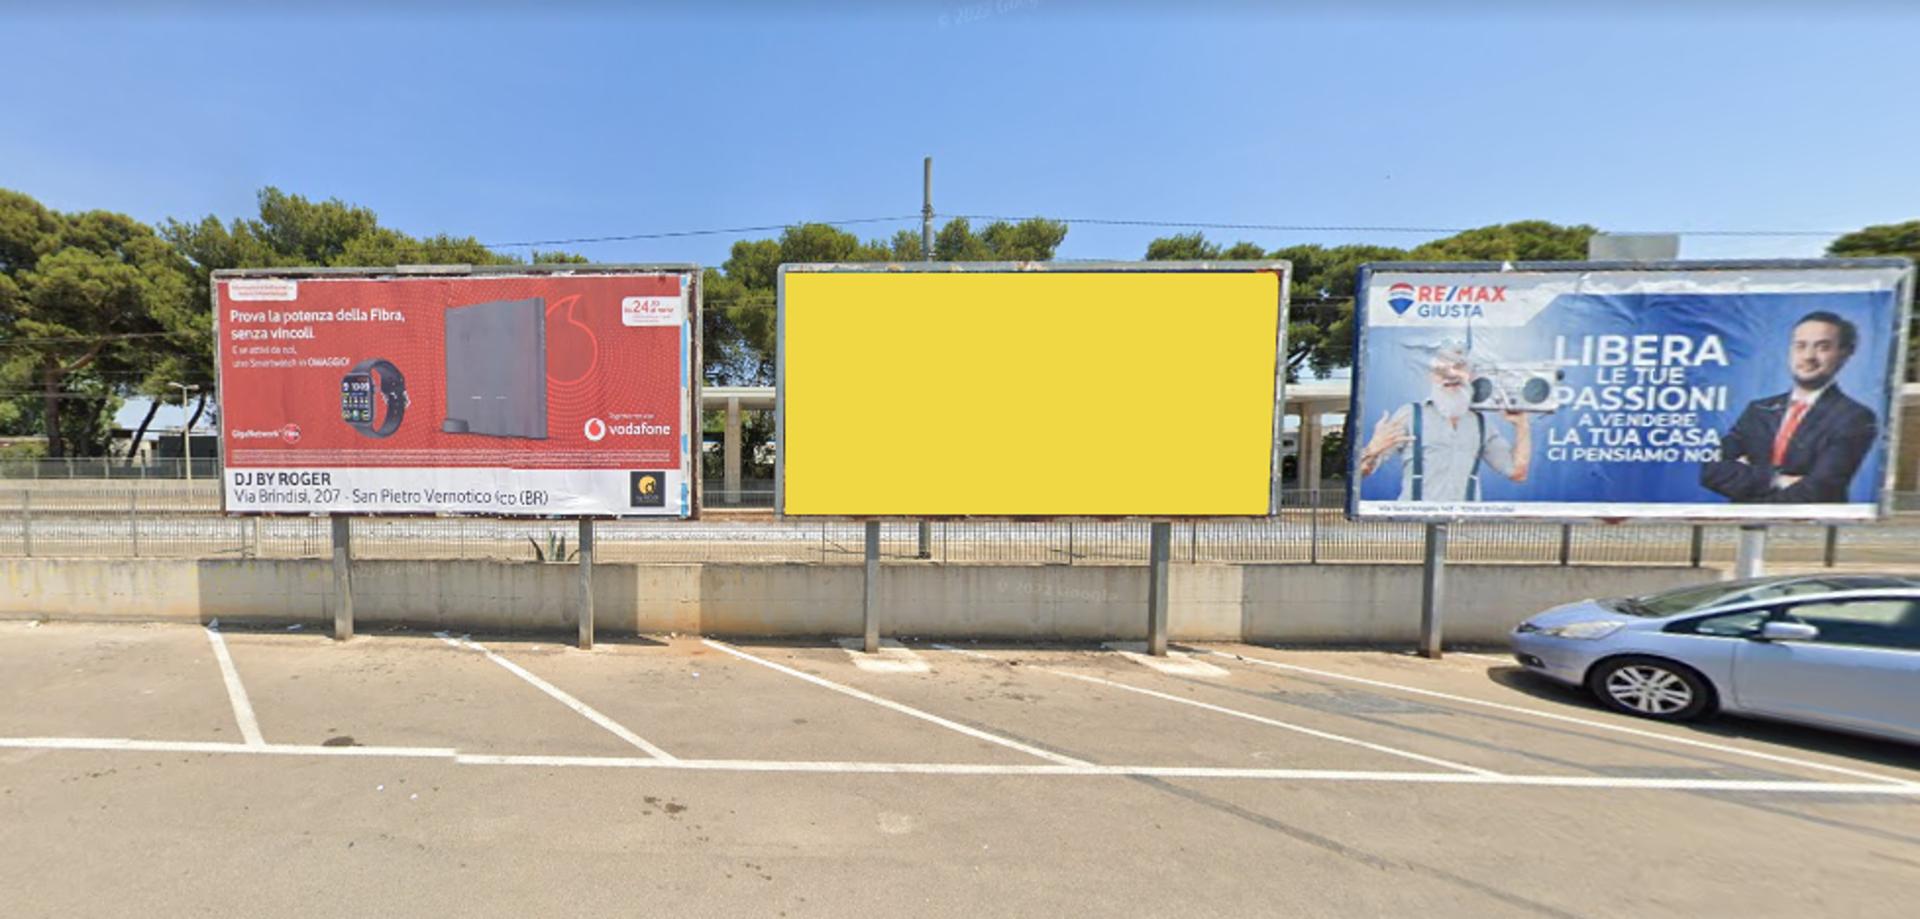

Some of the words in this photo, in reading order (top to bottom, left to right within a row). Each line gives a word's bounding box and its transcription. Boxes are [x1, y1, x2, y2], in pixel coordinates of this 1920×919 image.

[1418, 285, 1508, 303] RE/MAX
[230, 309, 266, 323] Prova
[268, 309, 282, 323] la
[283, 310, 334, 327] potenza
[335, 309, 369, 322] della
[370, 308, 405, 324] Fibra,
[1417, 303, 1483, 318] GIUSTA
[231, 328, 268, 341] senza
[272, 326, 316, 340] vincoli.
[1554, 335, 1729, 367] LIBERA
[1596, 367, 1627, 386] LE
[1634, 367, 1685, 386] TUE
[1552, 386, 1727, 412] PASSIONI
[608, 422, 671, 436] vodafone
[1578, 413, 1593, 427] A
[1599, 413, 1697, 427] VENDERE
[1549, 428, 1581, 446] LA
[1588, 428, 1641, 446] TUA
[1647, 428, 1721, 446] CASA
[1548, 448, 1566, 461] CI
[1572, 448, 1679, 462] PENSIAMO
[1684, 449, 1722, 463] NOI
[235, 472, 252, 486] DJ
[256, 472, 275, 486] BY
[278, 472, 331, 486] ROGER
[234, 489, 256, 504] Via
[260, 488, 312, 506] Brindisi,
[315, 489, 341, 504] 207
[352, 489, 378, 504] San
[382, 488, 421, 504] Pietro
[424, 488, 492, 504] Vernotico
[519, 490, 549, 506] (BR)
